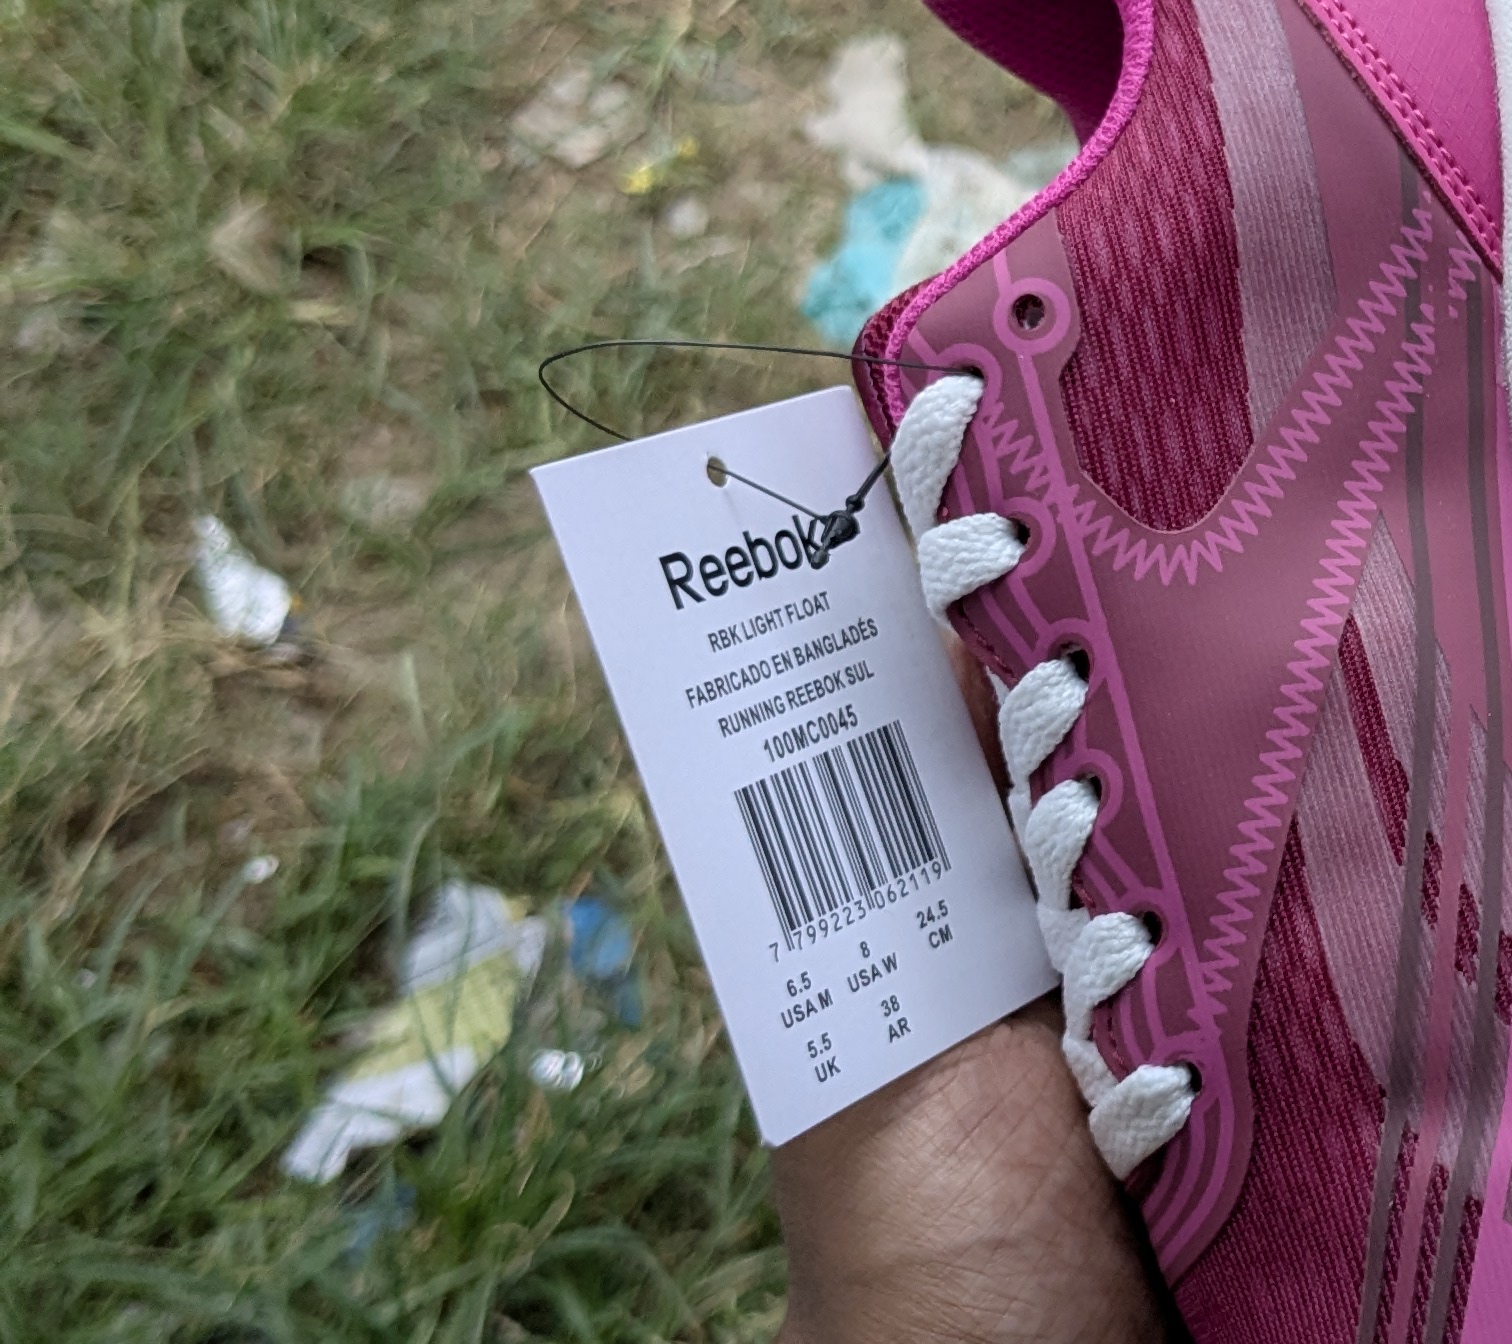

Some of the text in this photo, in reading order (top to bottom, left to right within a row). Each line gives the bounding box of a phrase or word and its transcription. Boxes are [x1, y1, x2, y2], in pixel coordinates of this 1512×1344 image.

[658, 514, 827, 610] Reebok
[707, 591, 831, 653] RBK LIGHT FLOAT
[685, 617, 879, 709] FABRICADO EN BANGLADÉS
[718, 660, 875, 738] RUNNING REEBOK SUL
[763, 704, 858, 763] 100MC0045
[916, 899, 949, 929] 24.5
[859, 940, 871, 959] 8
[928, 924, 953, 949] CM
[786, 970, 812, 997] 6.5
[847, 952, 899, 993] USA W
[780, 988, 834, 1029] USA M
[880, 994, 901, 1018] 38
[888, 1016, 912, 1044] AR
[807, 1032, 832, 1059] 5.5
[814, 1056, 841, 1083] UK
